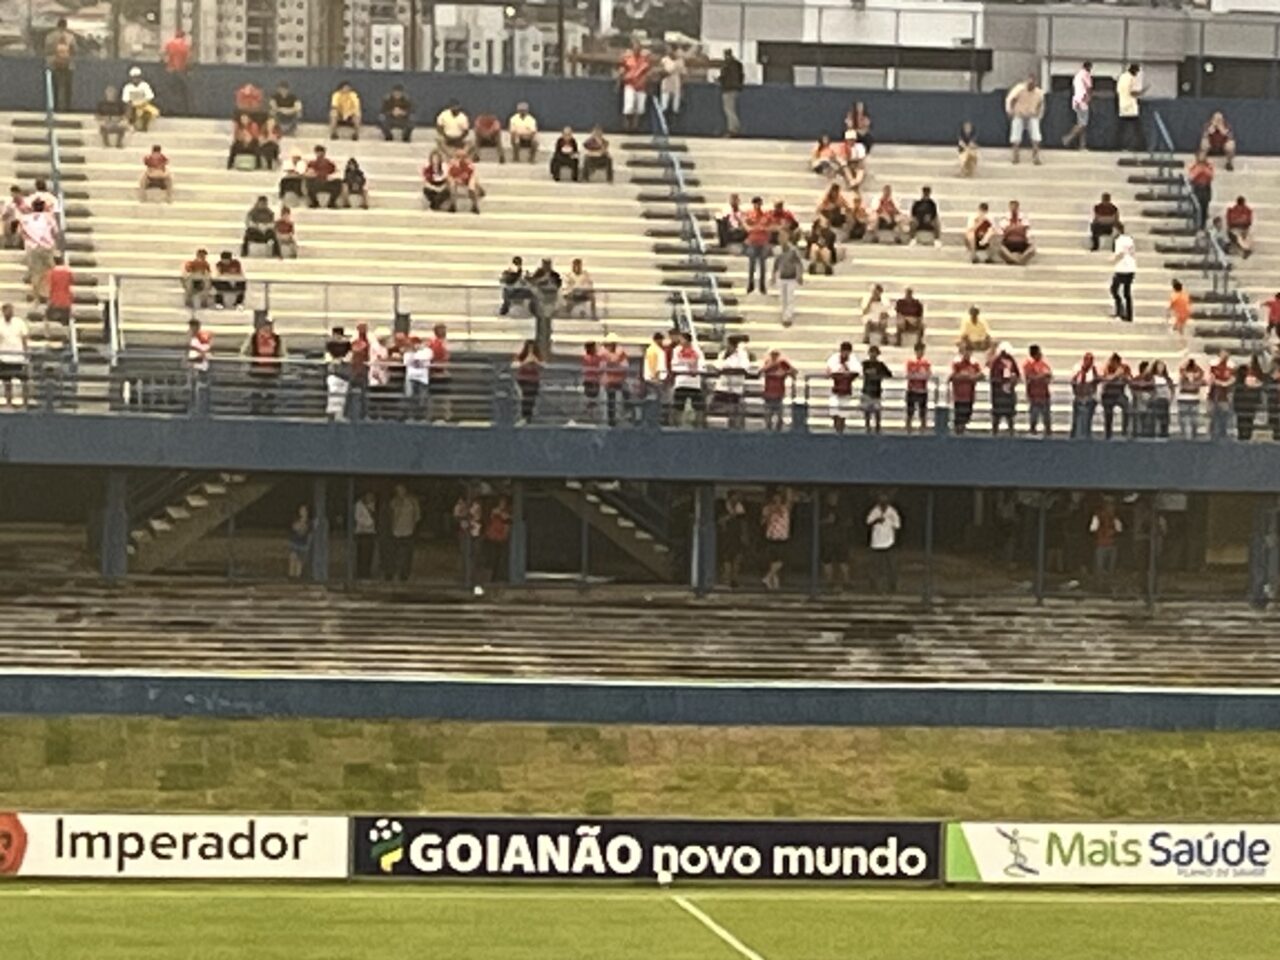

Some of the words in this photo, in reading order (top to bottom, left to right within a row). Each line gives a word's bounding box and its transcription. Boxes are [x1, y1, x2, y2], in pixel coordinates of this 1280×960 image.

[57, 817, 308, 873] Imperador
[409, 825, 642, 874] GOIANÃO
[652, 845, 762, 876] novo
[773, 836, 928, 876] mundo
[1046, 830, 1142, 867] Mais
[1149, 831, 1271, 867] Saúde
